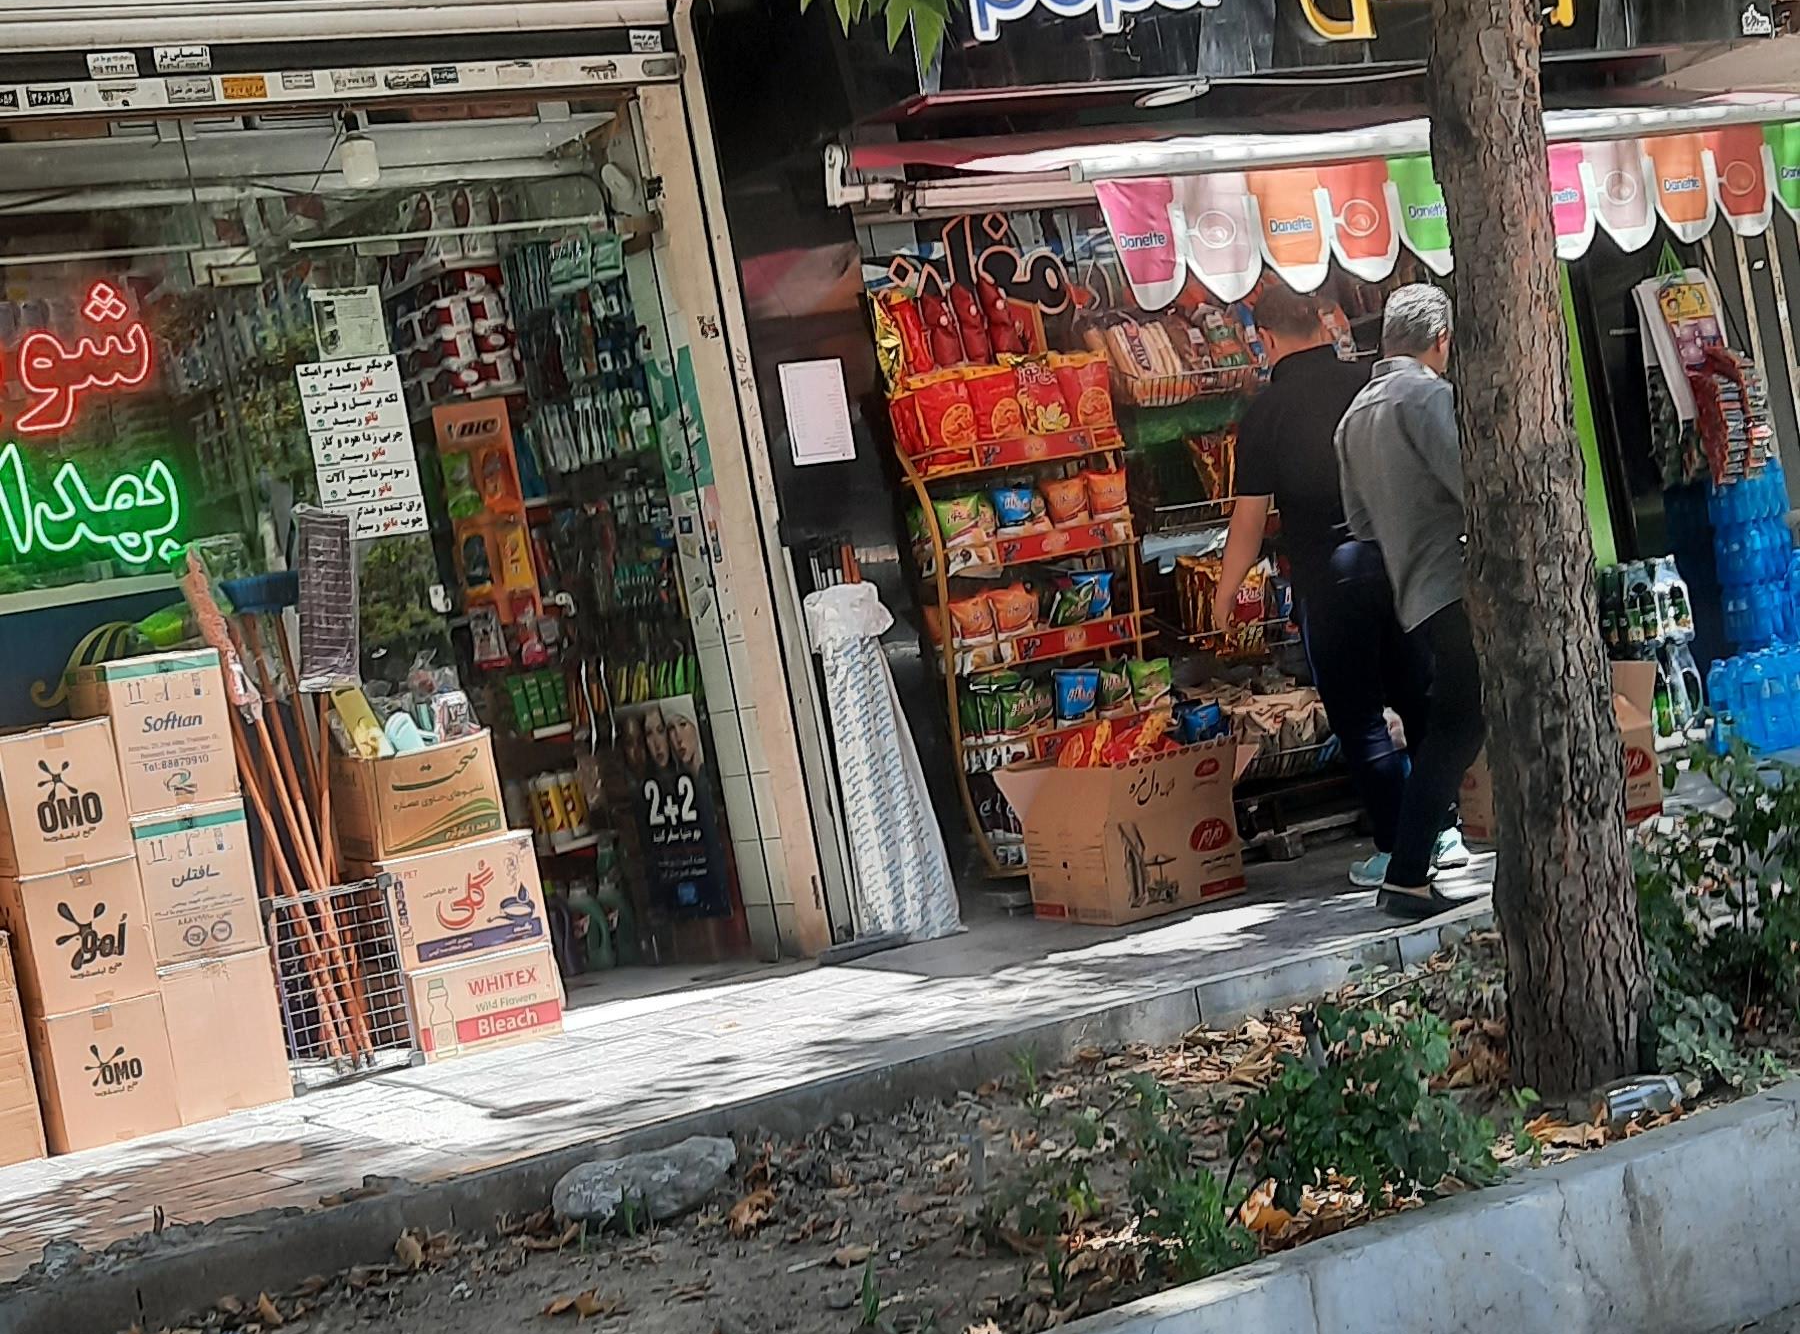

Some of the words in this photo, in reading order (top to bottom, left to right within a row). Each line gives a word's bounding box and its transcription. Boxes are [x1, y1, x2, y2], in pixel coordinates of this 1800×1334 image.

[1664, 175, 1700, 192] Danette
[1553, 188, 1579, 204] nette
[1408, 202, 1446, 219] Danett
[1269, 217, 1313, 234] Danette
[1119, 231, 1166, 251] Danette
[342, 361, 362, 372] سنگ
[327, 381, 358, 393] رسید
[332, 417, 362, 427] رسید
[458, 418, 498, 437] BIC
[340, 453, 370, 463] رسید
[346, 488, 376, 499] رسید
[400, 516, 423, 529] چوب
[142, 710, 203, 734] Softlan
[644, 775, 698, 827] 2+2
[37, 791, 104, 834] OMO
[467, 966, 538, 996] WHITEX
[475, 998, 498, 1013] Wild
[499, 992, 538, 1008] Flowers
[477, 1008, 539, 1038] Bleach
[101, 1057, 143, 1085] OMO
